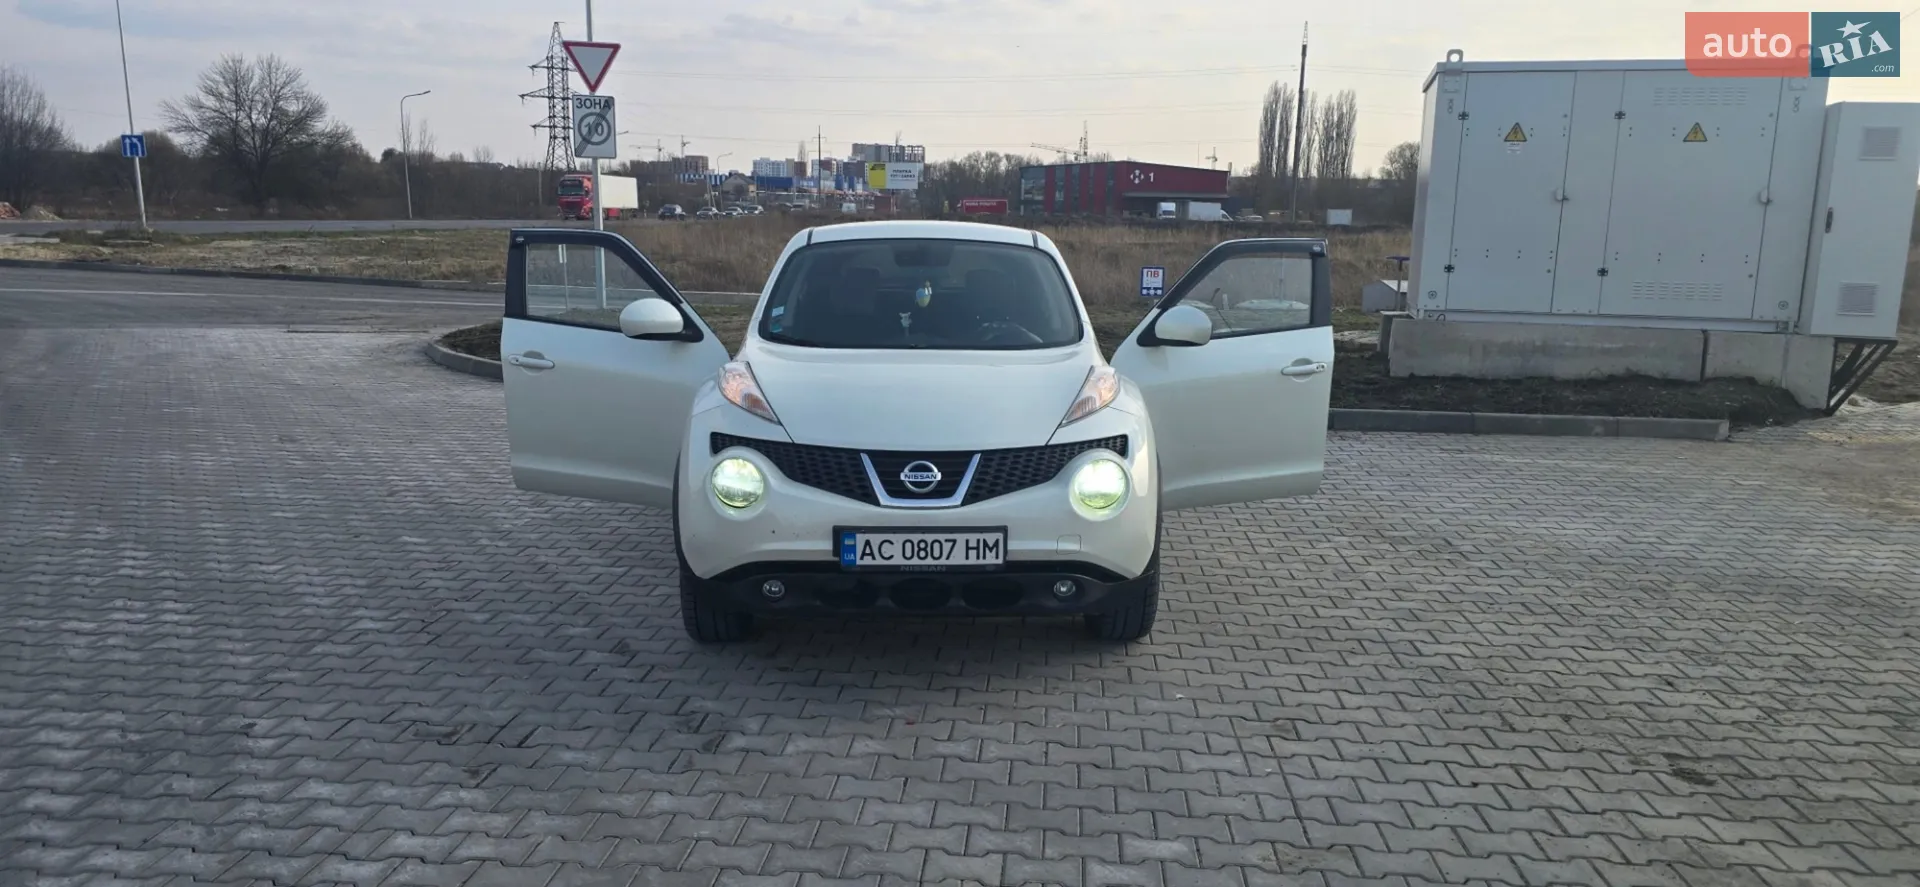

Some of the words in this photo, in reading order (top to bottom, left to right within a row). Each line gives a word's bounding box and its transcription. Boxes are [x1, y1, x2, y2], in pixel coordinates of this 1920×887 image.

[575, 98, 611, 109] ЗОНА
[584, 122, 605, 136] 10
[1149, 172, 1154, 182] 1
[859, 539, 894, 560] AC
[902, 539, 957, 560] 0807
[965, 538, 1000, 560] HM
